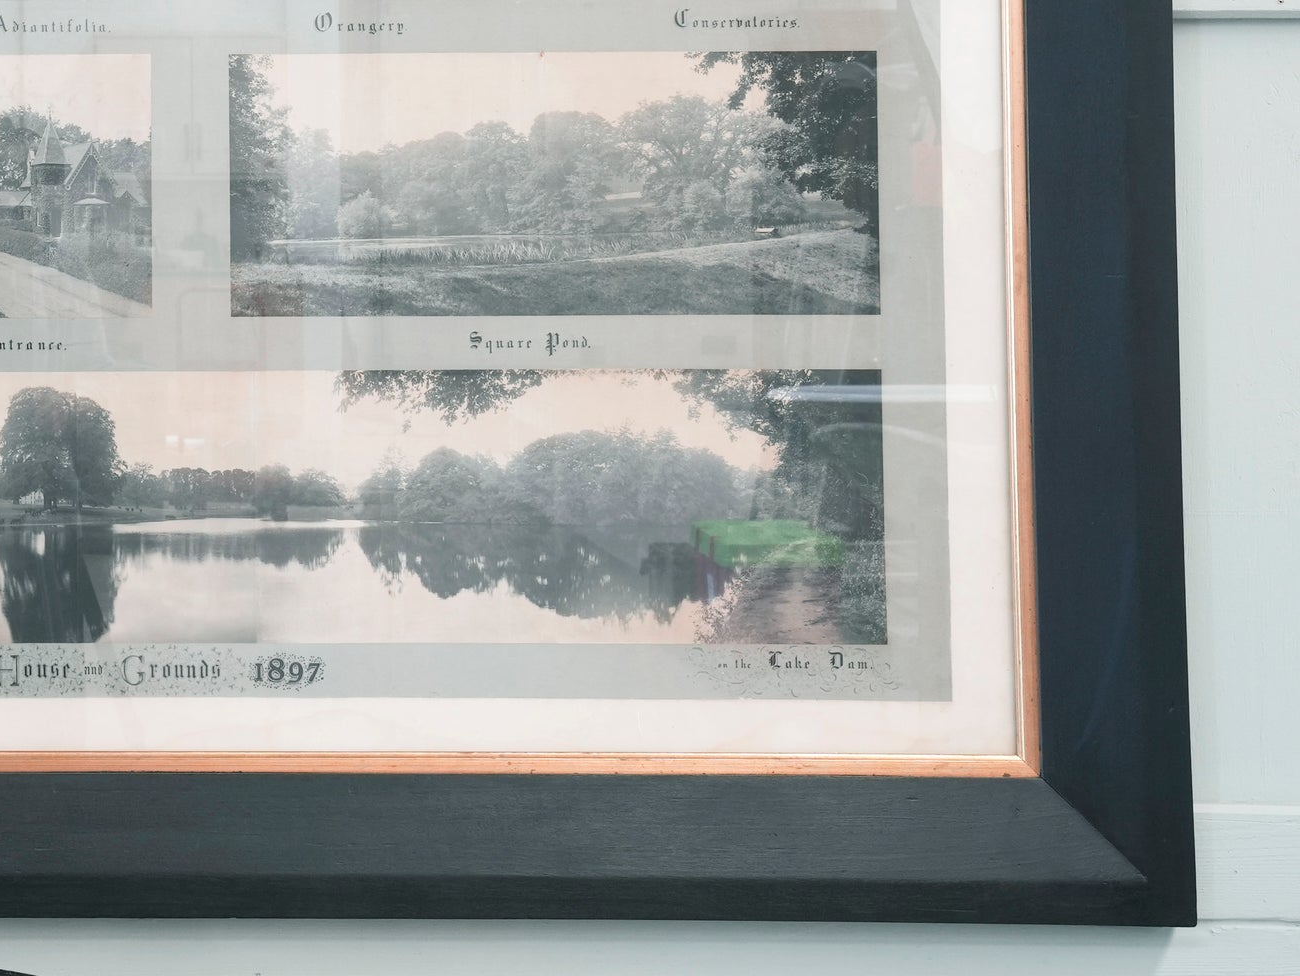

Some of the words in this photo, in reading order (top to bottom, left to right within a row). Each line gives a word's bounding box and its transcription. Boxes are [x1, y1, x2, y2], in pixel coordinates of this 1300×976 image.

[674, 8, 800, 29] Conservatories.
[469, 331, 532, 354] Square
[545, 332, 591, 356] Pond.
[83, 663, 103, 676] and
[120, 654, 222, 686] Grounds
[252, 657, 325, 685] 1897
[734, 658, 751, 670] the
[768, 650, 810, 670] Lake
[828, 650, 873, 670] Dam.
